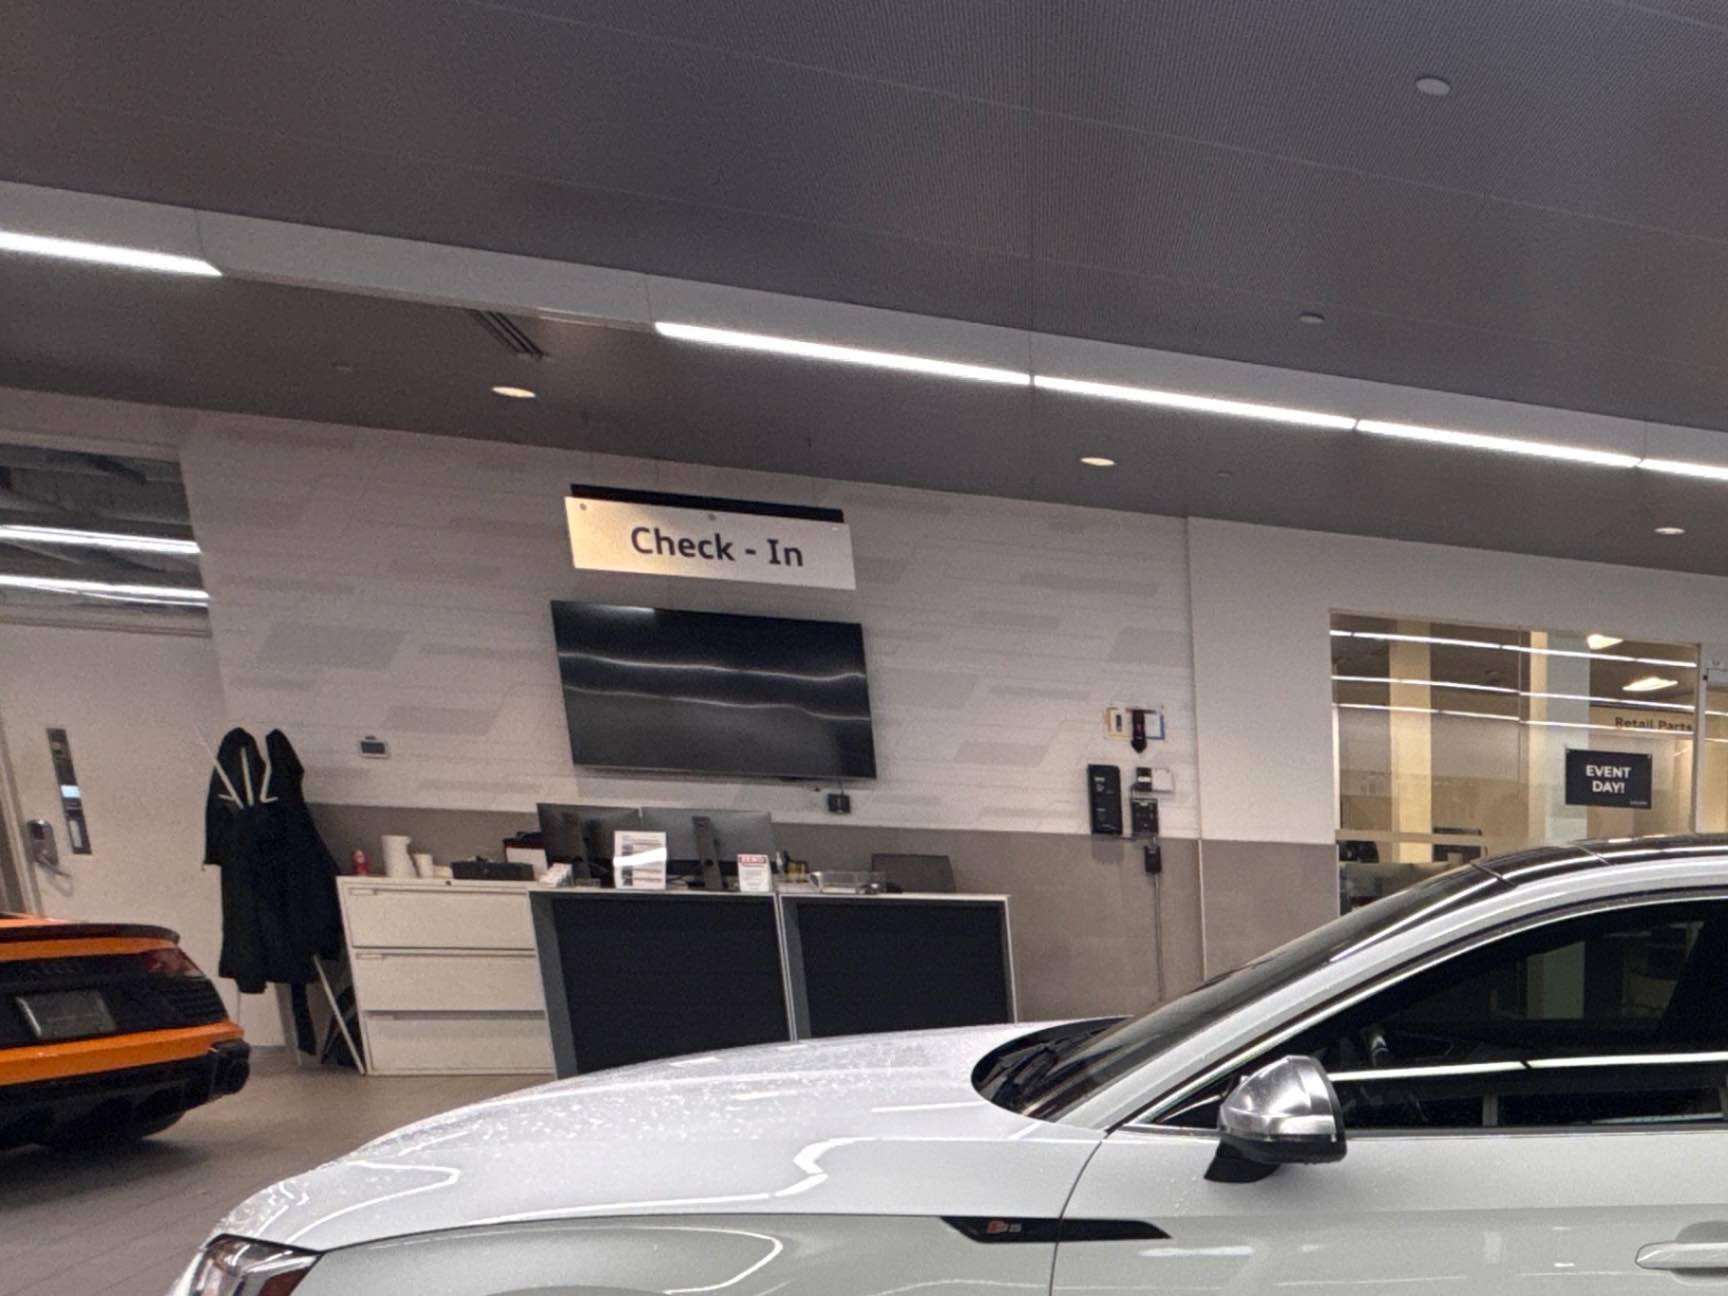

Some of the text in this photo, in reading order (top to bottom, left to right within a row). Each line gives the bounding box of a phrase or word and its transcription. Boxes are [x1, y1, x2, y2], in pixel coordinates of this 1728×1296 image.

[630, 526, 804, 567] Check - In
[1614, 716, 1693, 732] Retail Parts
[1585, 764, 1632, 778] EVENT
[1592, 781, 1626, 794] DAY!
